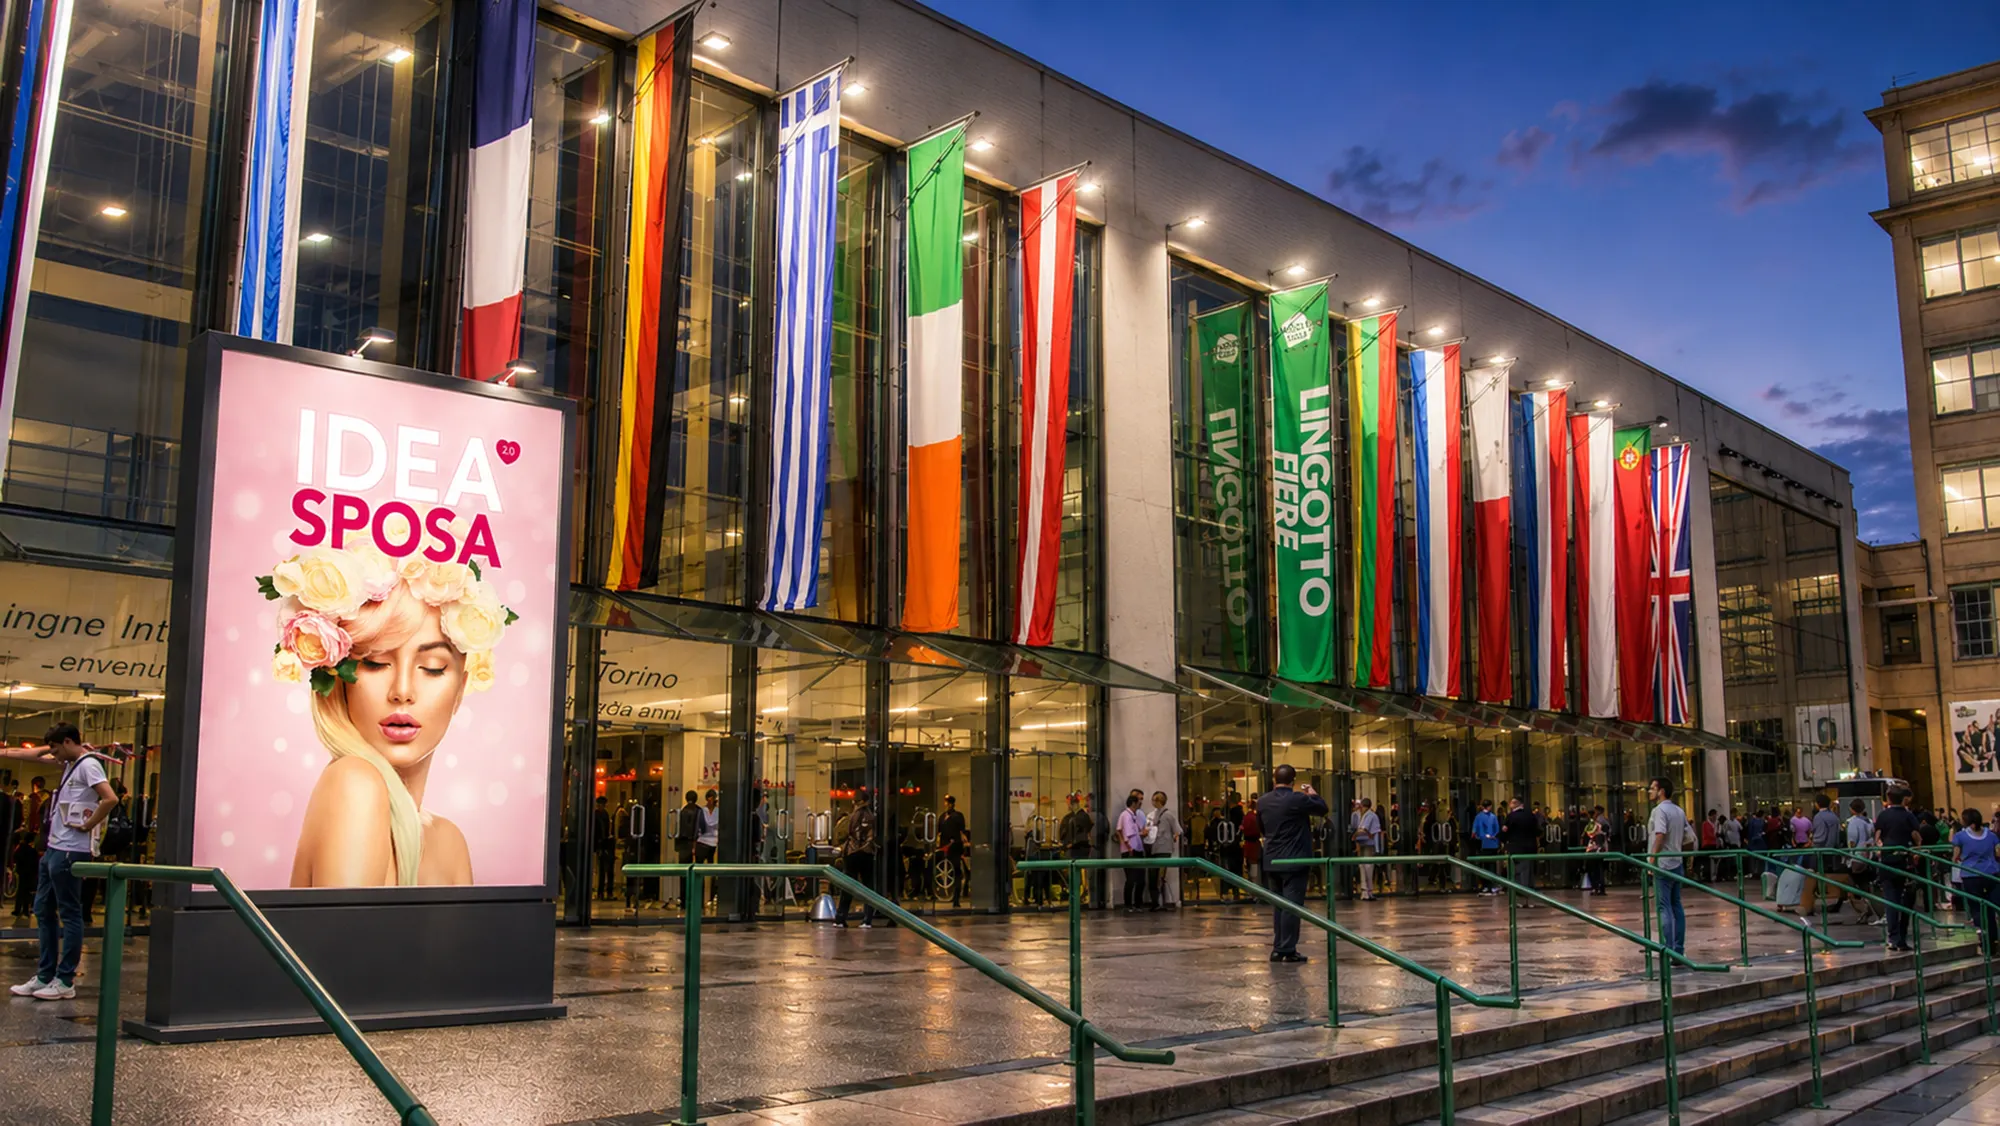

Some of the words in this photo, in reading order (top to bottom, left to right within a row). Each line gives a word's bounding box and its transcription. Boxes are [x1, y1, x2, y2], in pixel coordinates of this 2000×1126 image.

[296, 408, 503, 513] IDEA
[1274, 449, 1299, 551] FIERE
[1300, 385, 1331, 617] LINGOTTO
[289, 488, 502, 568] SPOSA
[121, 614, 169, 643] Int
[599, 661, 678, 689] Torino
